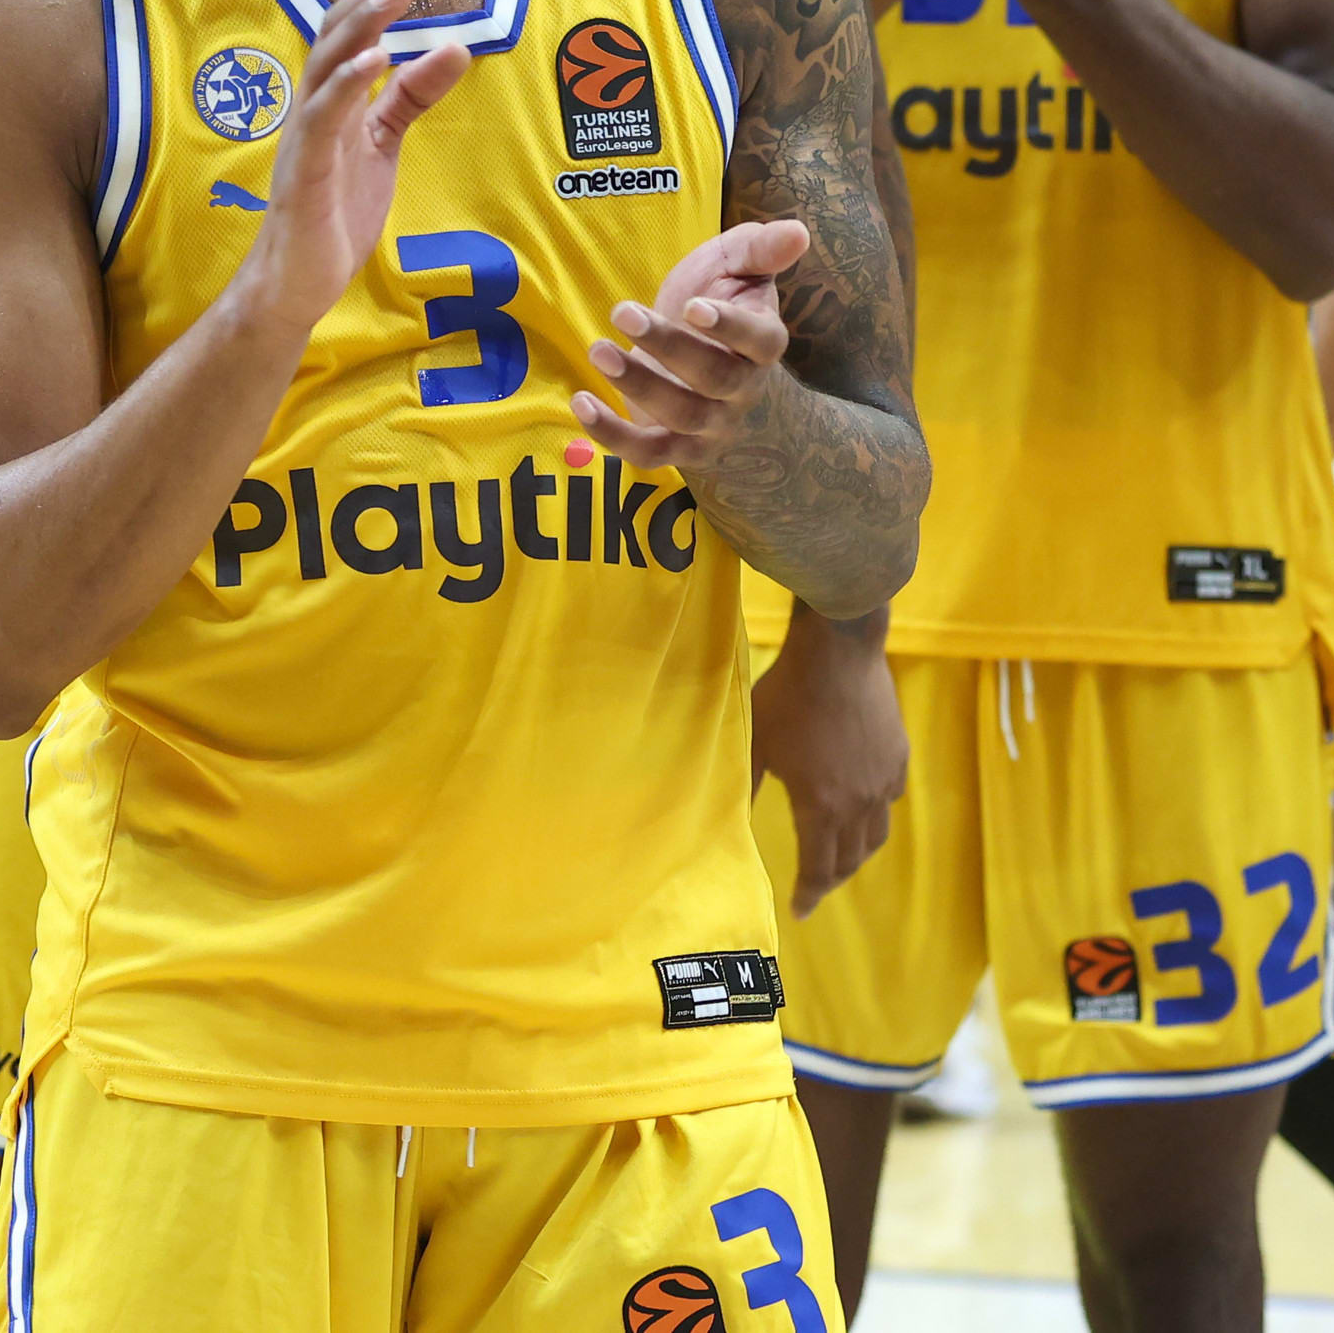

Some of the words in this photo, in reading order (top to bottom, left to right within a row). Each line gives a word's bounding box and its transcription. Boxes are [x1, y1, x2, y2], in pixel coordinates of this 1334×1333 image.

[572, 109, 650, 127] TURKISH
[575, 124, 652, 141] AIRLINES
[576, 139, 653, 153] EuroLeague
[557, 167, 679, 194] oneteam
[397, 230, 528, 407] 3
[1131, 852, 1319, 1027] 32
[665, 961, 702, 980] PUMA
[736, 961, 755, 988] M
[710, 1187, 828, 1333] 3
